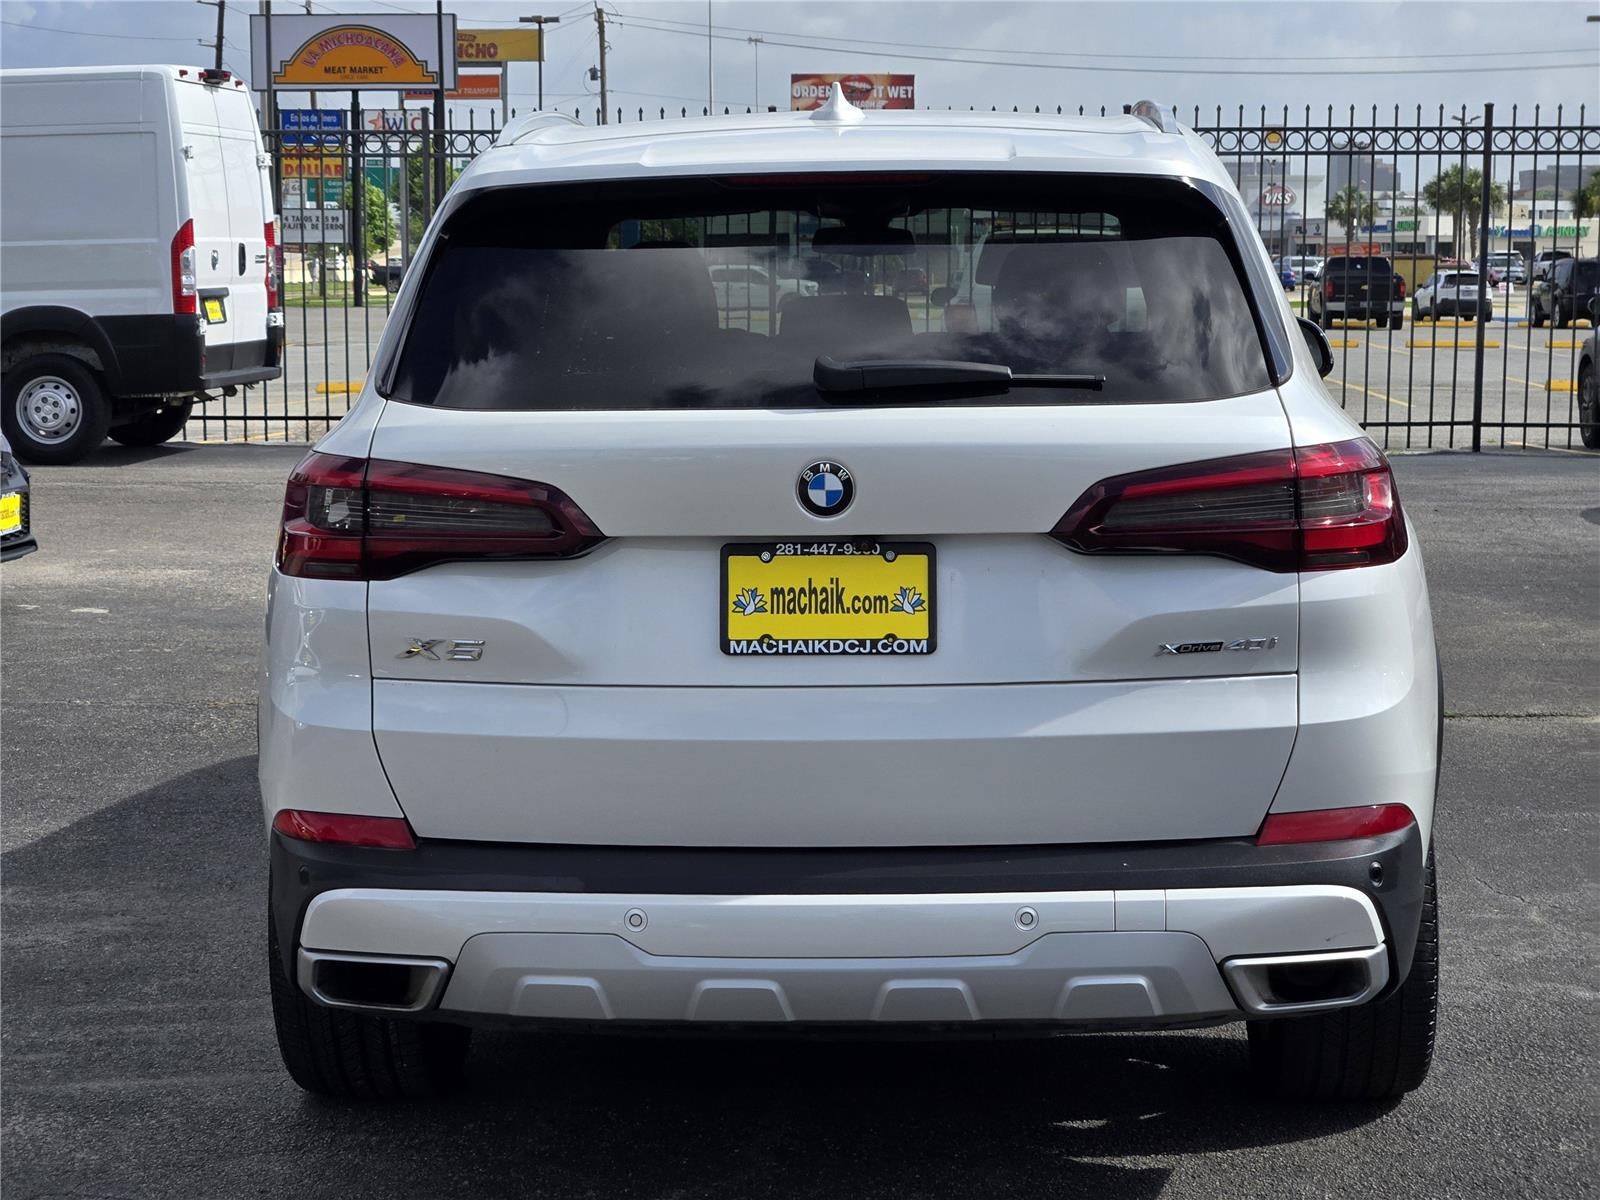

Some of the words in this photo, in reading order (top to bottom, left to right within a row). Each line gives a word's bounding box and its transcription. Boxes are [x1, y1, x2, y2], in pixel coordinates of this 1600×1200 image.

[303, 49, 321, 67] LA
[318, 33, 406, 67] MICHOACANA
[324, 66, 346, 74] MEAT
[349, 66, 384, 74] MARKET
[873, 85, 884, 98] IT
[888, 85, 913, 98] WET
[284, 163, 343, 177] DOLLAR
[803, 463, 849, 481] BMW
[770, 577, 889, 615] machaik.com
[395, 638, 485, 661] X5
[730, 639, 928, 654] MACHAIKDCJ.COM
